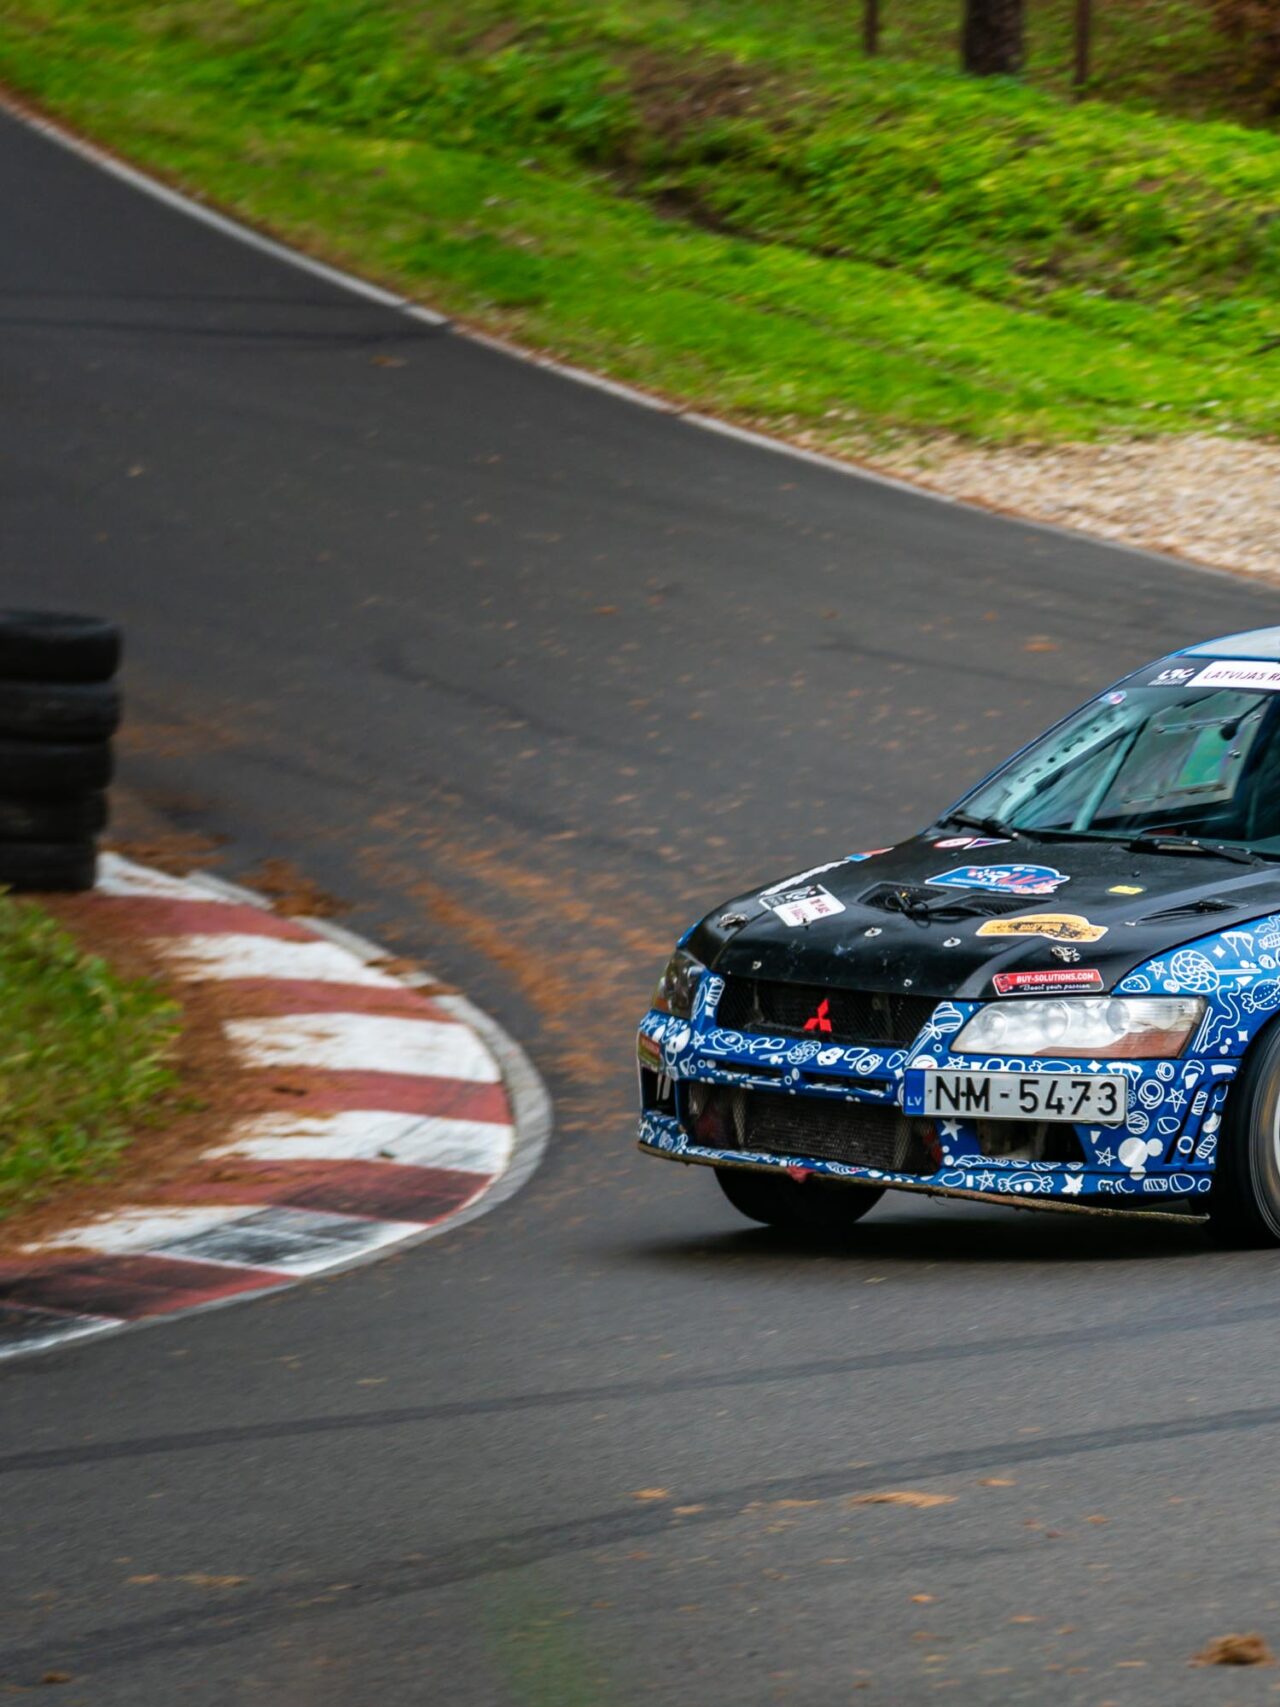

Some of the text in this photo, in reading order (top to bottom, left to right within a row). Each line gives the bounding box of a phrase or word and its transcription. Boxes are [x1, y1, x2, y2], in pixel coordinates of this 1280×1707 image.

[1203, 670, 1266, 680] LATVIJAS
[1016, 973, 1094, 984] BUY-SOLUTIONS.COM
[907, 1096, 922, 1106] LV
